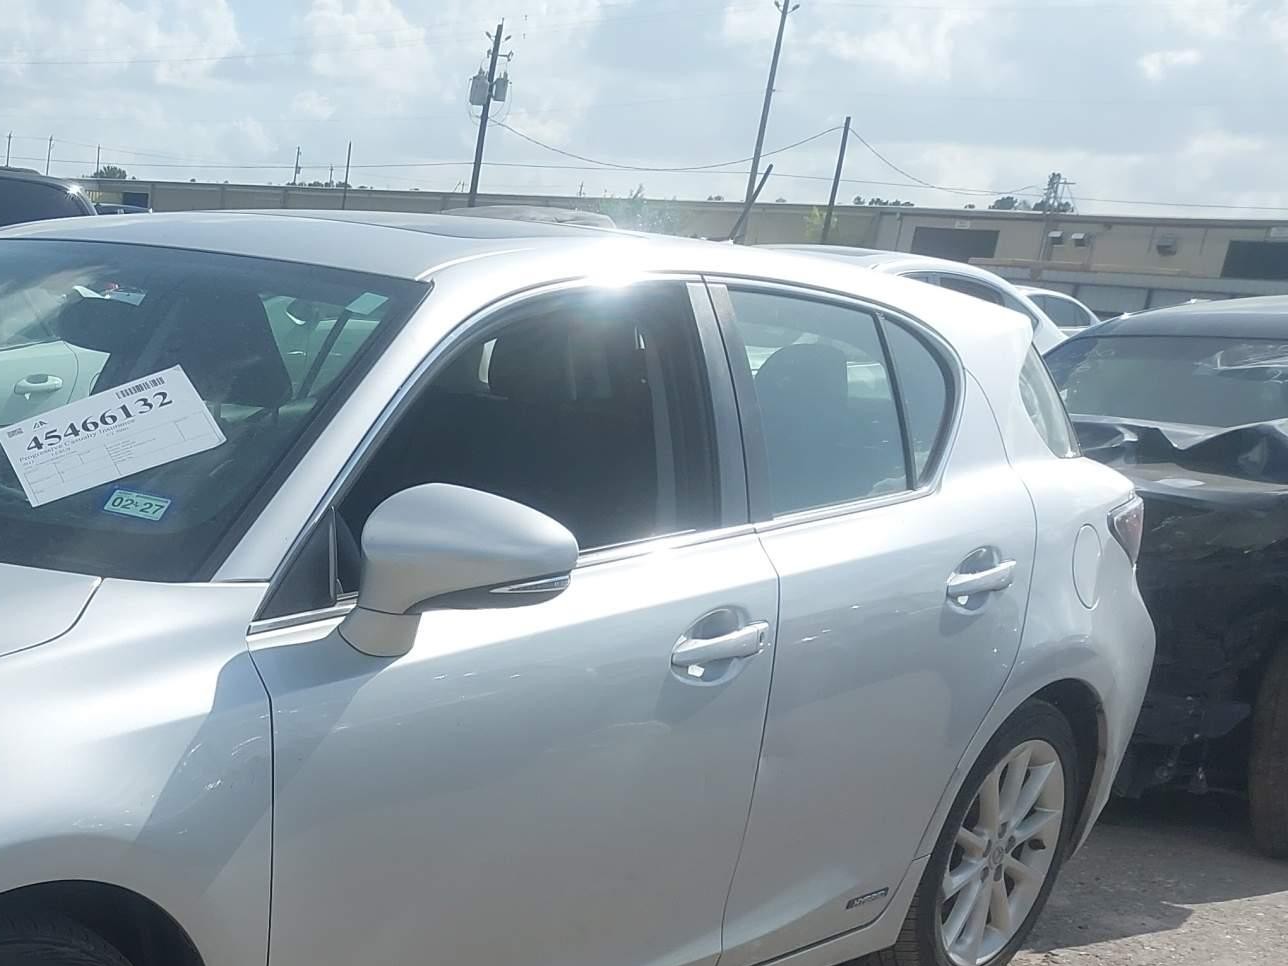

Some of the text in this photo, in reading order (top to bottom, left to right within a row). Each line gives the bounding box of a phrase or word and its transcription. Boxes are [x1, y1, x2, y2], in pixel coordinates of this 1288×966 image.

[26, 391, 173, 451] 45466132
[111, 496, 165, 515] 02 27
